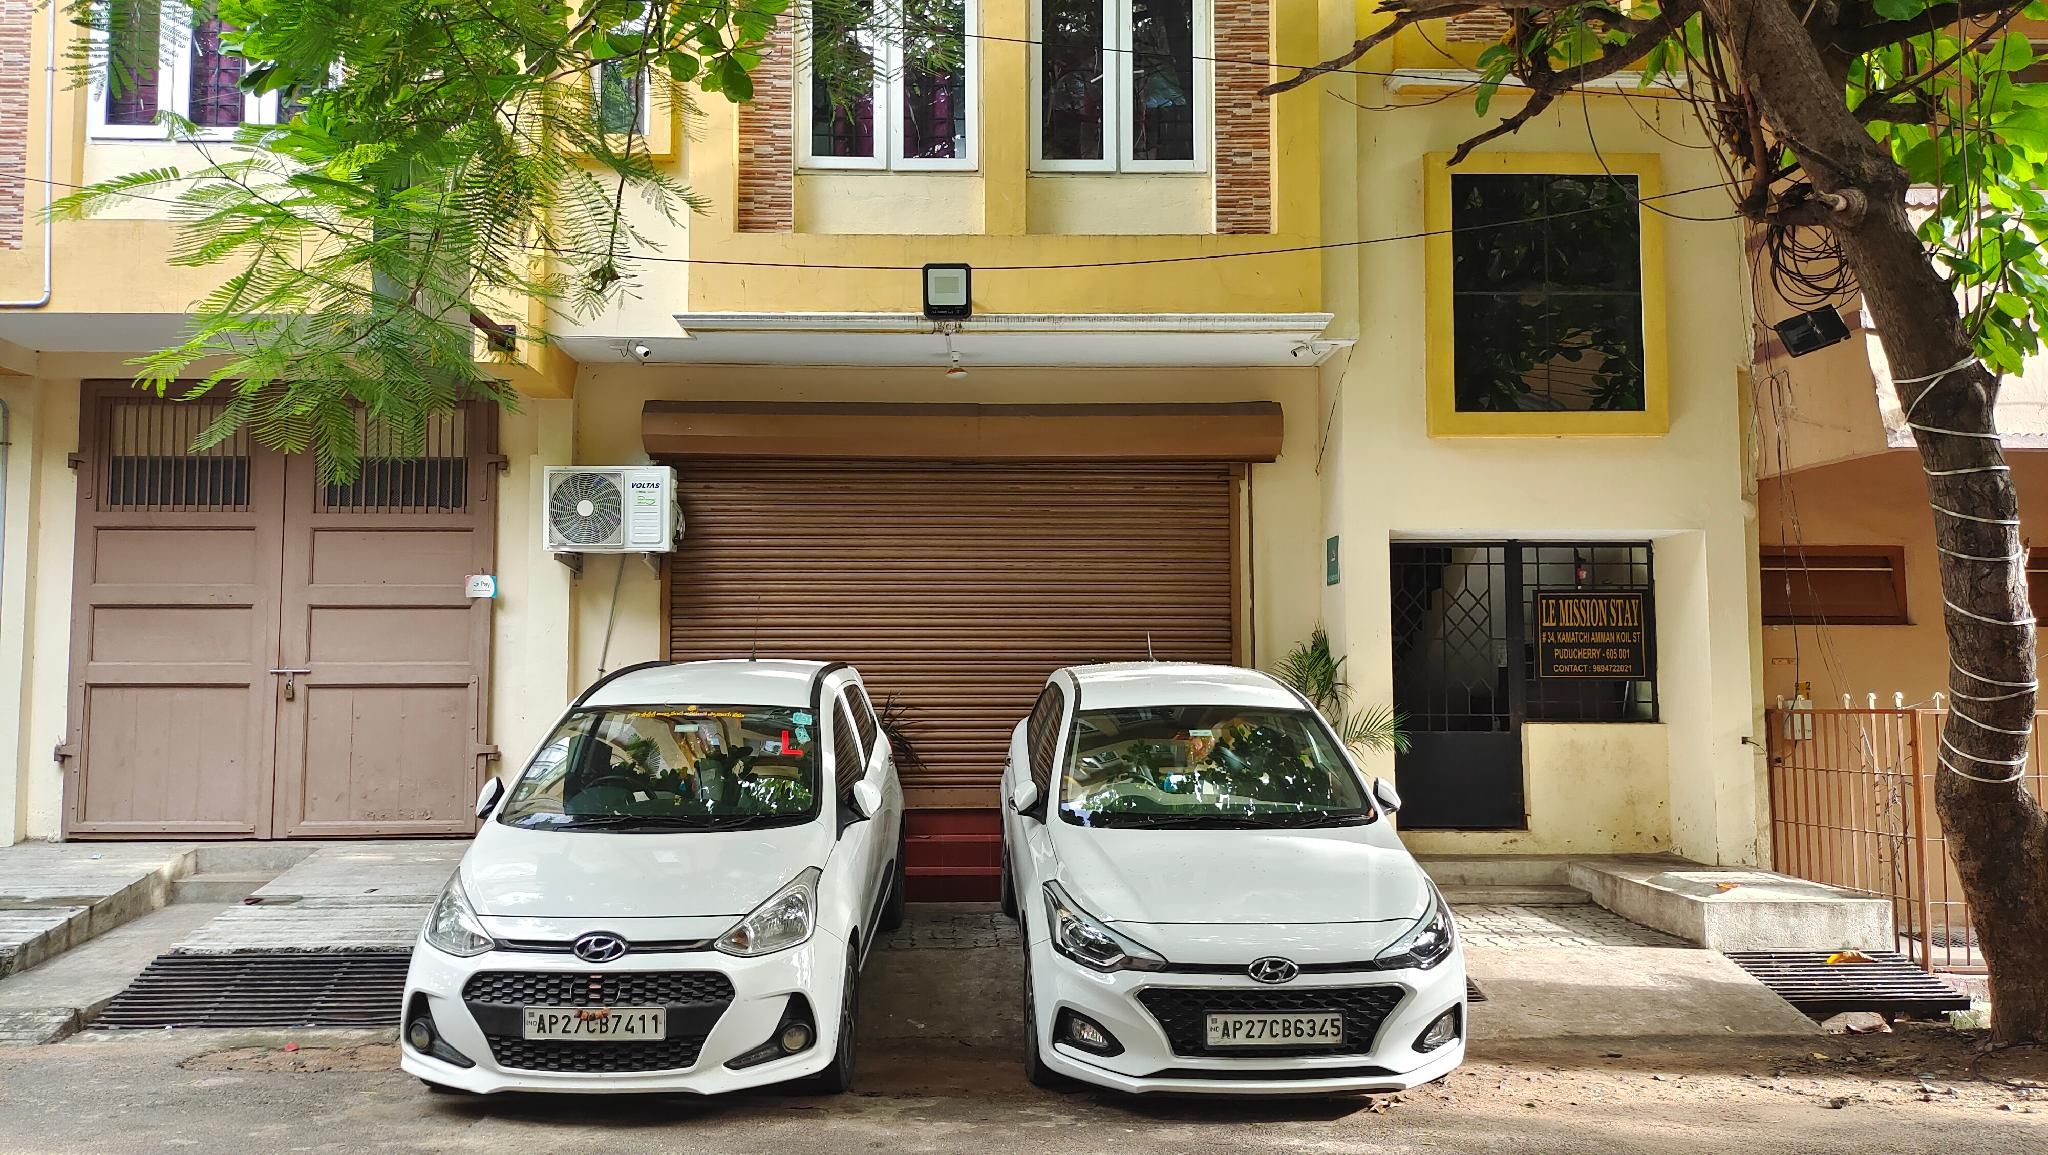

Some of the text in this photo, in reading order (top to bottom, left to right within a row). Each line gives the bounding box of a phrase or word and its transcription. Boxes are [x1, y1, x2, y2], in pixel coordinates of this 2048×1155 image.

[1542, 599, 1639, 627] LE MISSION STAY
[1557, 631, 1590, 643] KAMATCHI
[1590, 631, 1615, 643] AMMAN
[1616, 631, 1631, 643] KOIL
[1632, 631, 1641, 643] ST
[1554, 648, 1601, 659] PUDUCHERRY
[1606, 648, 1618, 659] 605
[1618, 648, 1630, 659] 001
[1553, 664, 1588, 673] CONTACT
[782, 730, 804, 754] L
[537, 1014, 659, 1034] AP27CB7411
[1221, 1018, 1341, 1039] AP27CB6345
